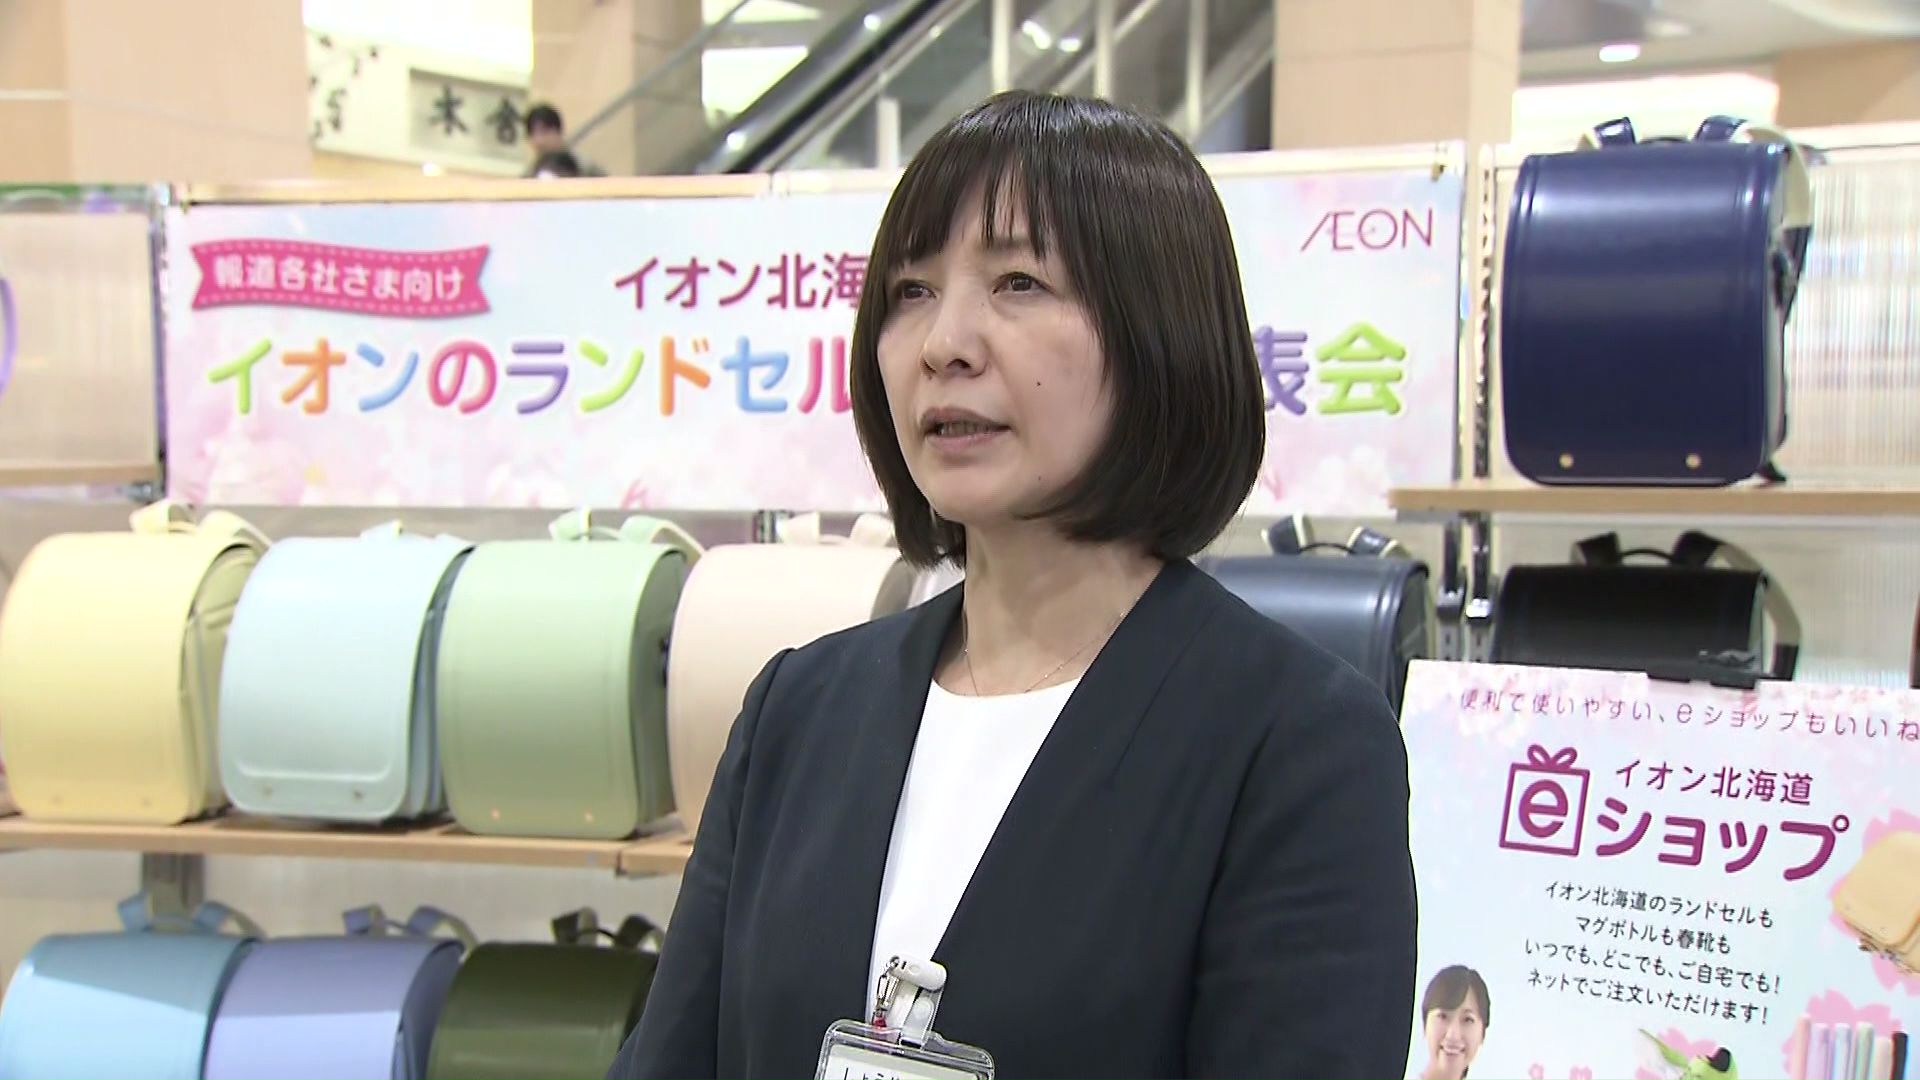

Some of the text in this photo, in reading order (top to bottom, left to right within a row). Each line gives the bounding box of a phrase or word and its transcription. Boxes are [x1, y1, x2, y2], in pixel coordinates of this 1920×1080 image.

[212, 253, 464, 304] 報道各社さま向け
[1615, 759, 1814, 806] イオン北海道
[1545, 880, 1774, 929] イオン北海道のランドセルも
[1575, 915, 1731, 955] マグボトルも春靴も
